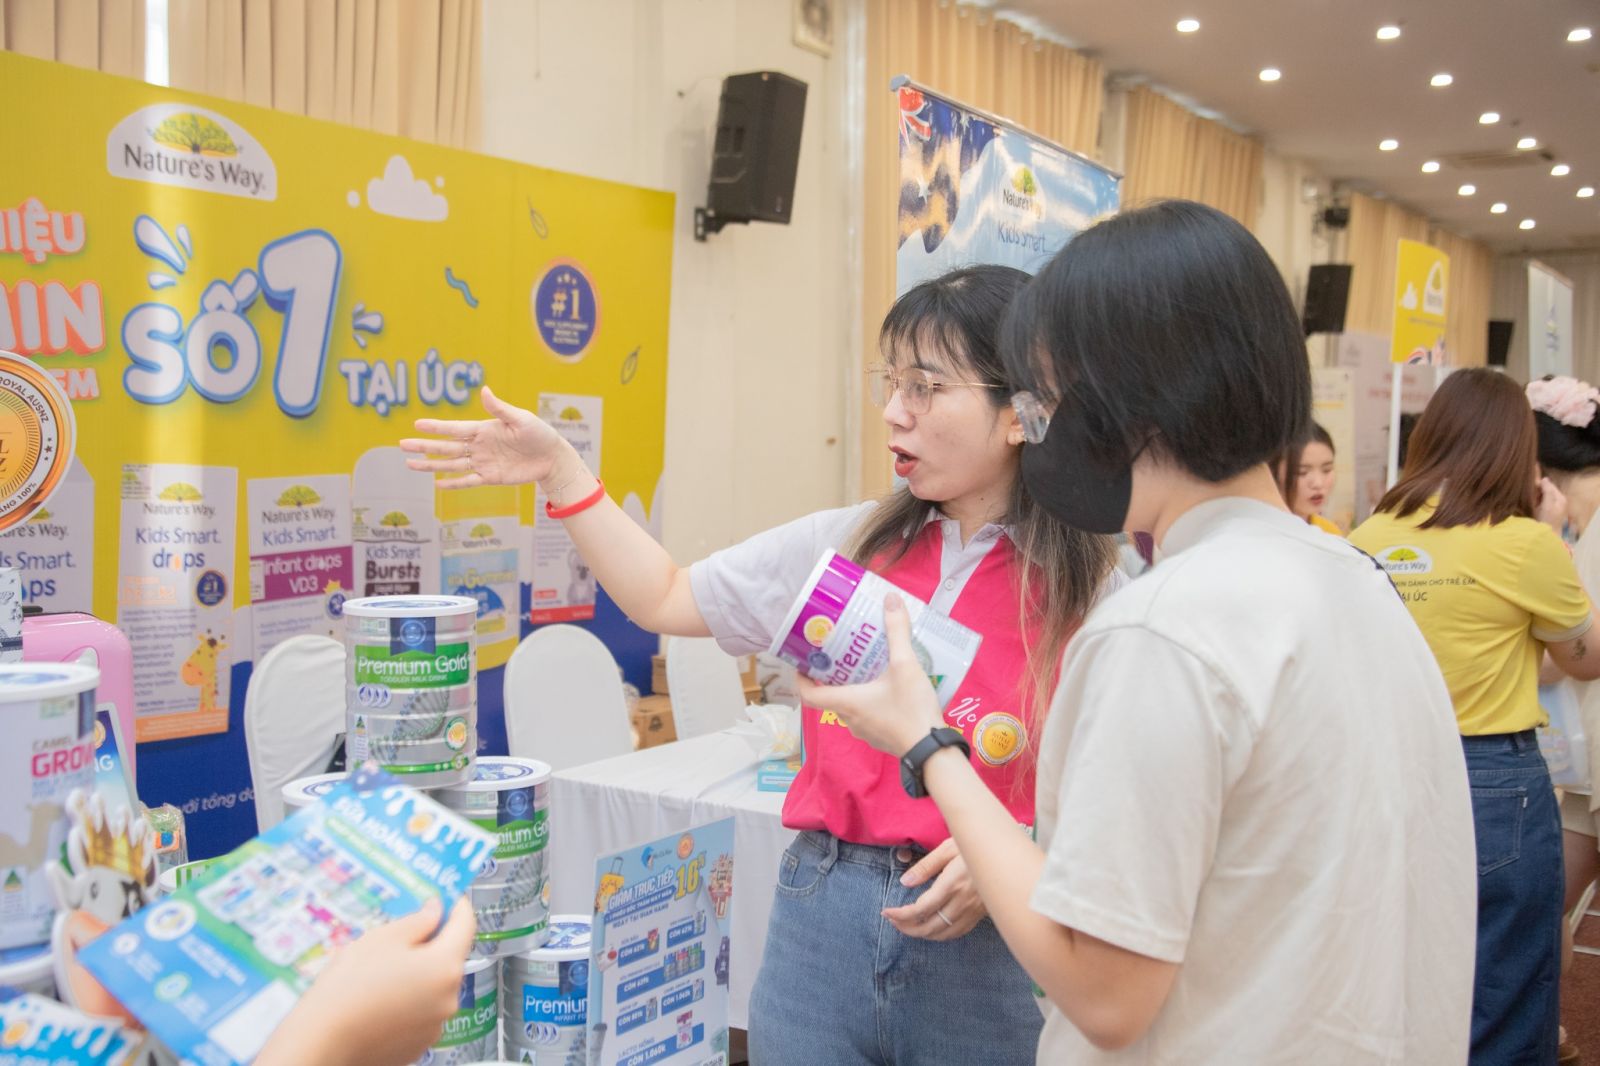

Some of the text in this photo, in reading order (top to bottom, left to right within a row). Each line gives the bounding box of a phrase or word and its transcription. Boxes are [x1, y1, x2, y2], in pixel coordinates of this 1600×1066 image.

[124, 143, 215, 182] Nature's
[258, 228, 343, 420] 1
[338, 360, 408, 418] TẠI
[135, 527, 170, 544] Kids
[262, 528, 294, 546] Kids
[365, 561, 421, 580] Bursts
[356, 656, 431, 676] Premium
